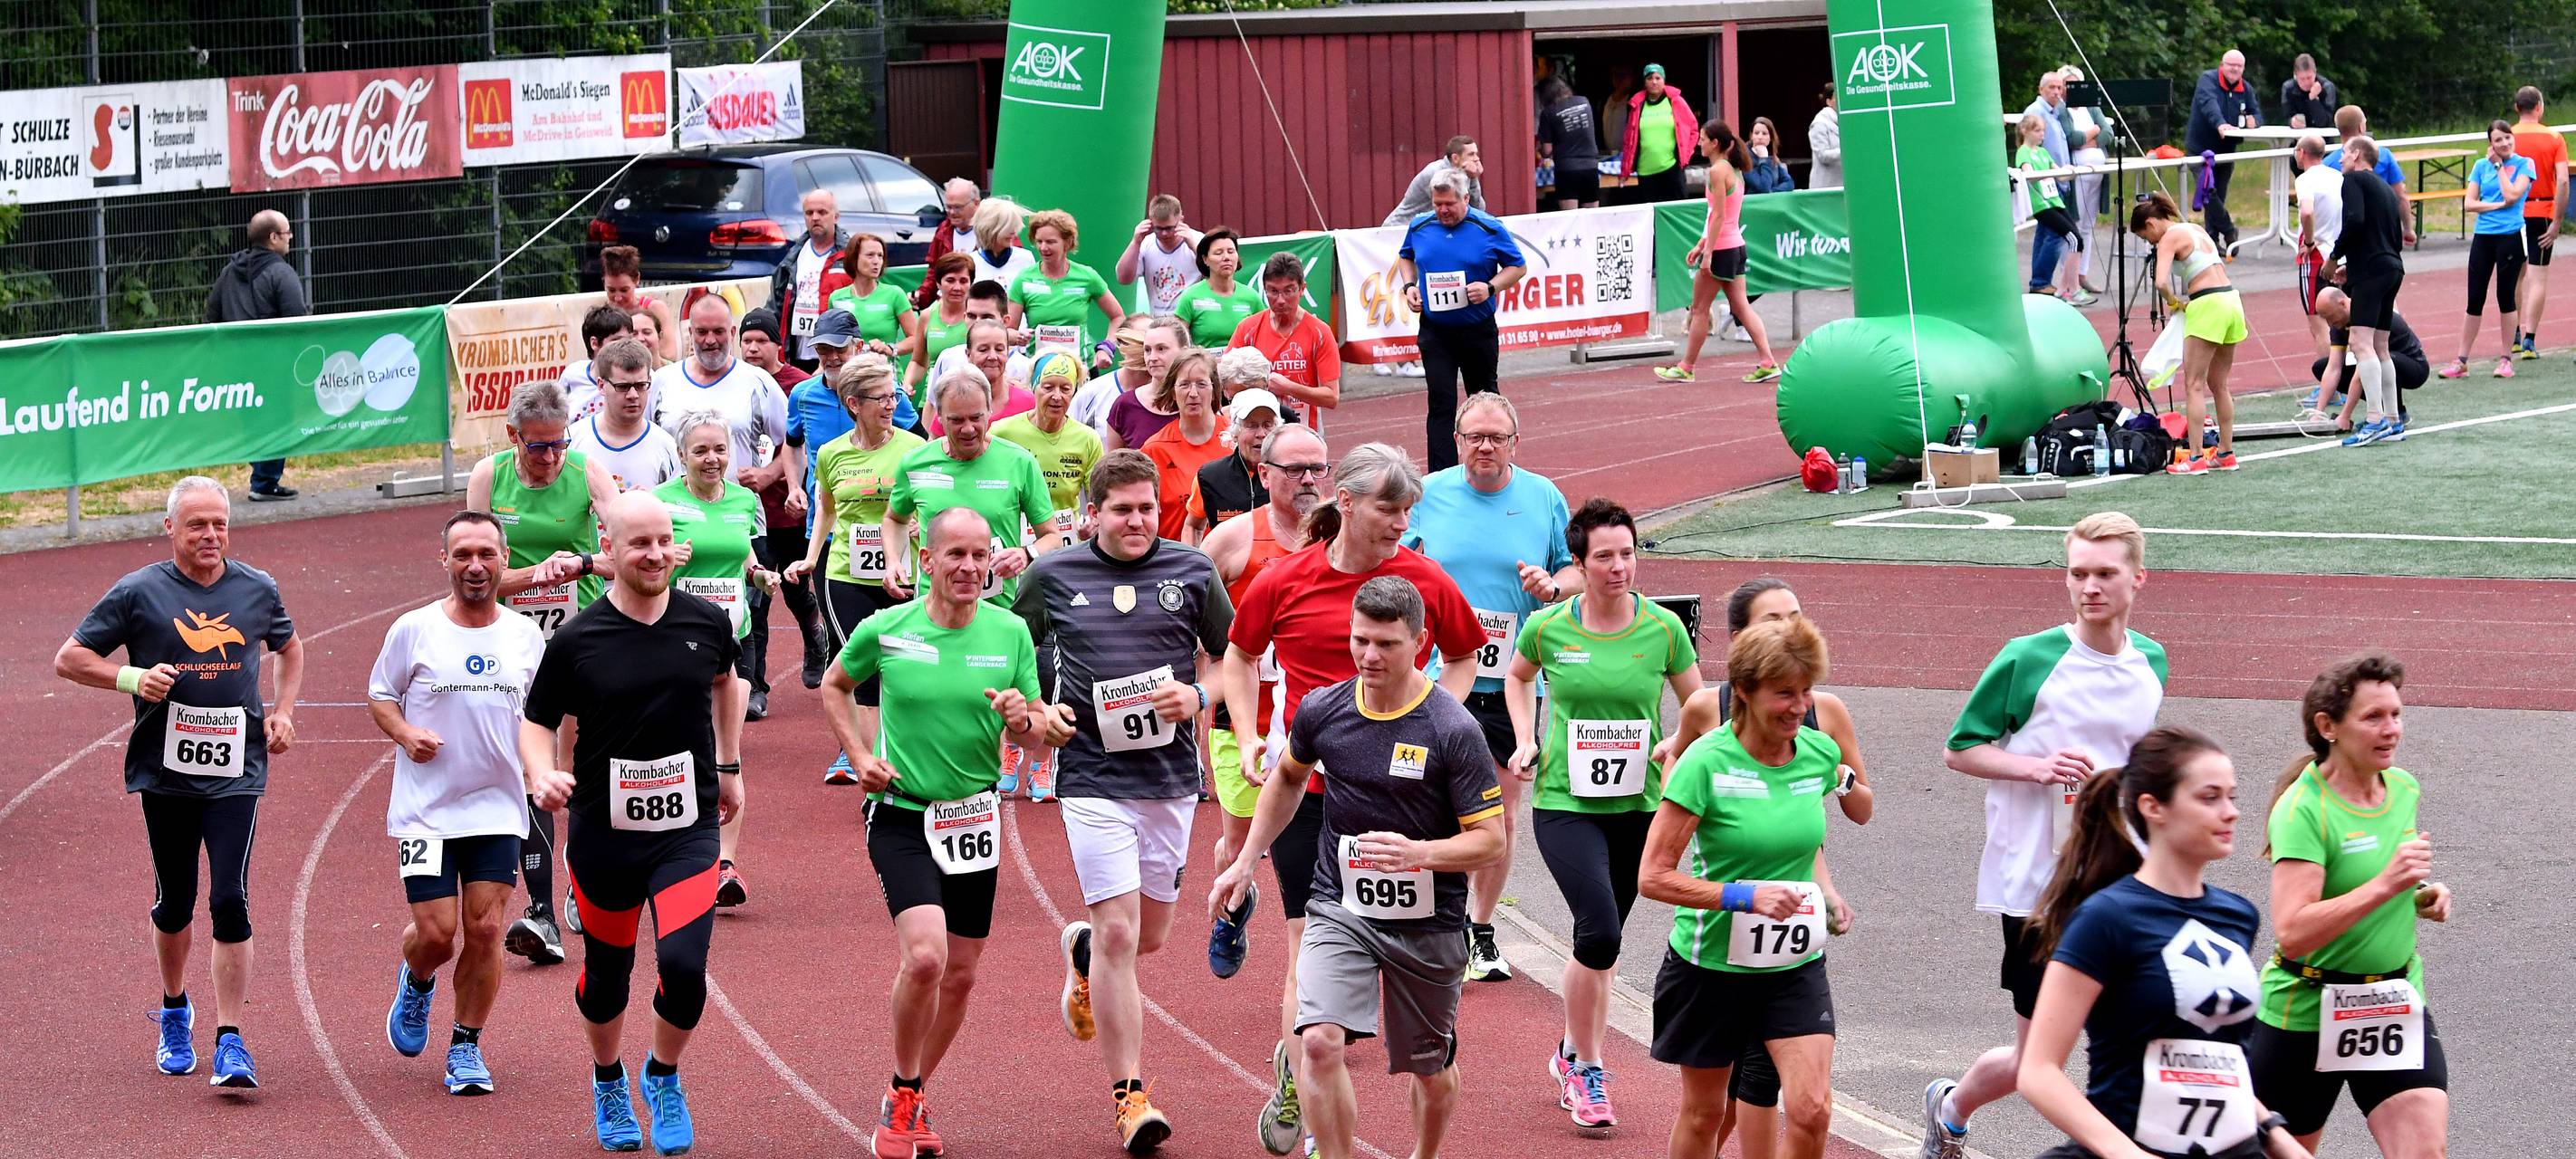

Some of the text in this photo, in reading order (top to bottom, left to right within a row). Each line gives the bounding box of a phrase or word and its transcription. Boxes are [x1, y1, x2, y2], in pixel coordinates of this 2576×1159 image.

[1011, 42, 1085, 81] AOK
[1847, 42, 1928, 84] AOK
[233, 90, 265, 113] Trink
[522, 80, 610, 101] McDonald's Siegen
[12, 118, 70, 143] SCHULZE
[259, 74, 436, 179] Coca-Cola
[1775, 230, 1808, 259] Wir
[1434, 290, 1458, 305] 111
[1496, 273, 1585, 313] RGER
[799, 317, 813, 330] 97
[457, 330, 569, 369] KROMBACHER'S
[320, 371, 349, 388] Alles
[352, 371, 364, 386] in
[0, 377, 264, 436] Laufend in Form.
[685, 580, 736, 594] Krombacher
[516, 596, 566, 604] ALKOHOLFREI
[520, 608, 566, 631] 72
[901, 631, 925, 643] Stefan
[199, 672, 217, 680] 2017
[177, 707, 239, 726] Krombacher
[1123, 709, 1159, 740] 91
[180, 724, 234, 734] ALKOHOLFREI
[1577, 724, 1643, 740] Krombacher
[177, 739, 232, 767] 663
[620, 761, 685, 781] Krombacher
[625, 776, 682, 788] ALKOHOLFREI
[1591, 758, 1628, 786] 87
[626, 791, 684, 821] 688
[934, 798, 992, 819] Krombacher
[939, 815, 990, 828] ALKOHOLFREI
[941, 830, 993, 862] 166
[1356, 877, 1418, 908] 695
[1750, 924, 1811, 954] 179
[2333, 986, 2409, 1009] Krombacher
[2337, 1023, 2404, 1058] 656
[2178, 1097, 2226, 1137] 77
